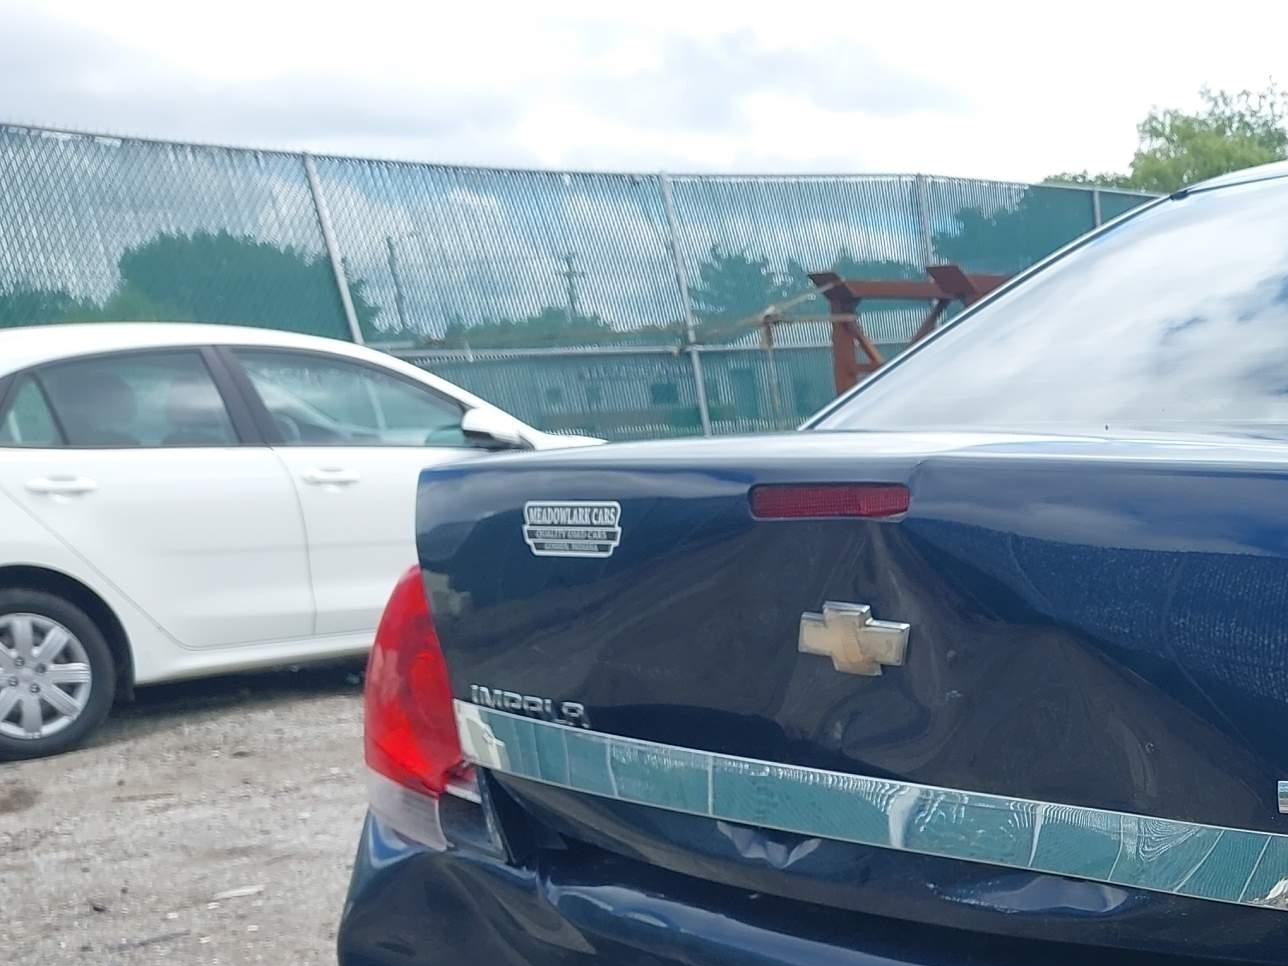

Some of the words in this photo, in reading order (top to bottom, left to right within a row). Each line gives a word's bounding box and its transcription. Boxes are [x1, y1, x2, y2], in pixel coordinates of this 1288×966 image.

[529, 507, 591, 525] MEADOWLARK
[591, 507, 616, 526] CARS
[470, 684, 590, 729] IMPALA
